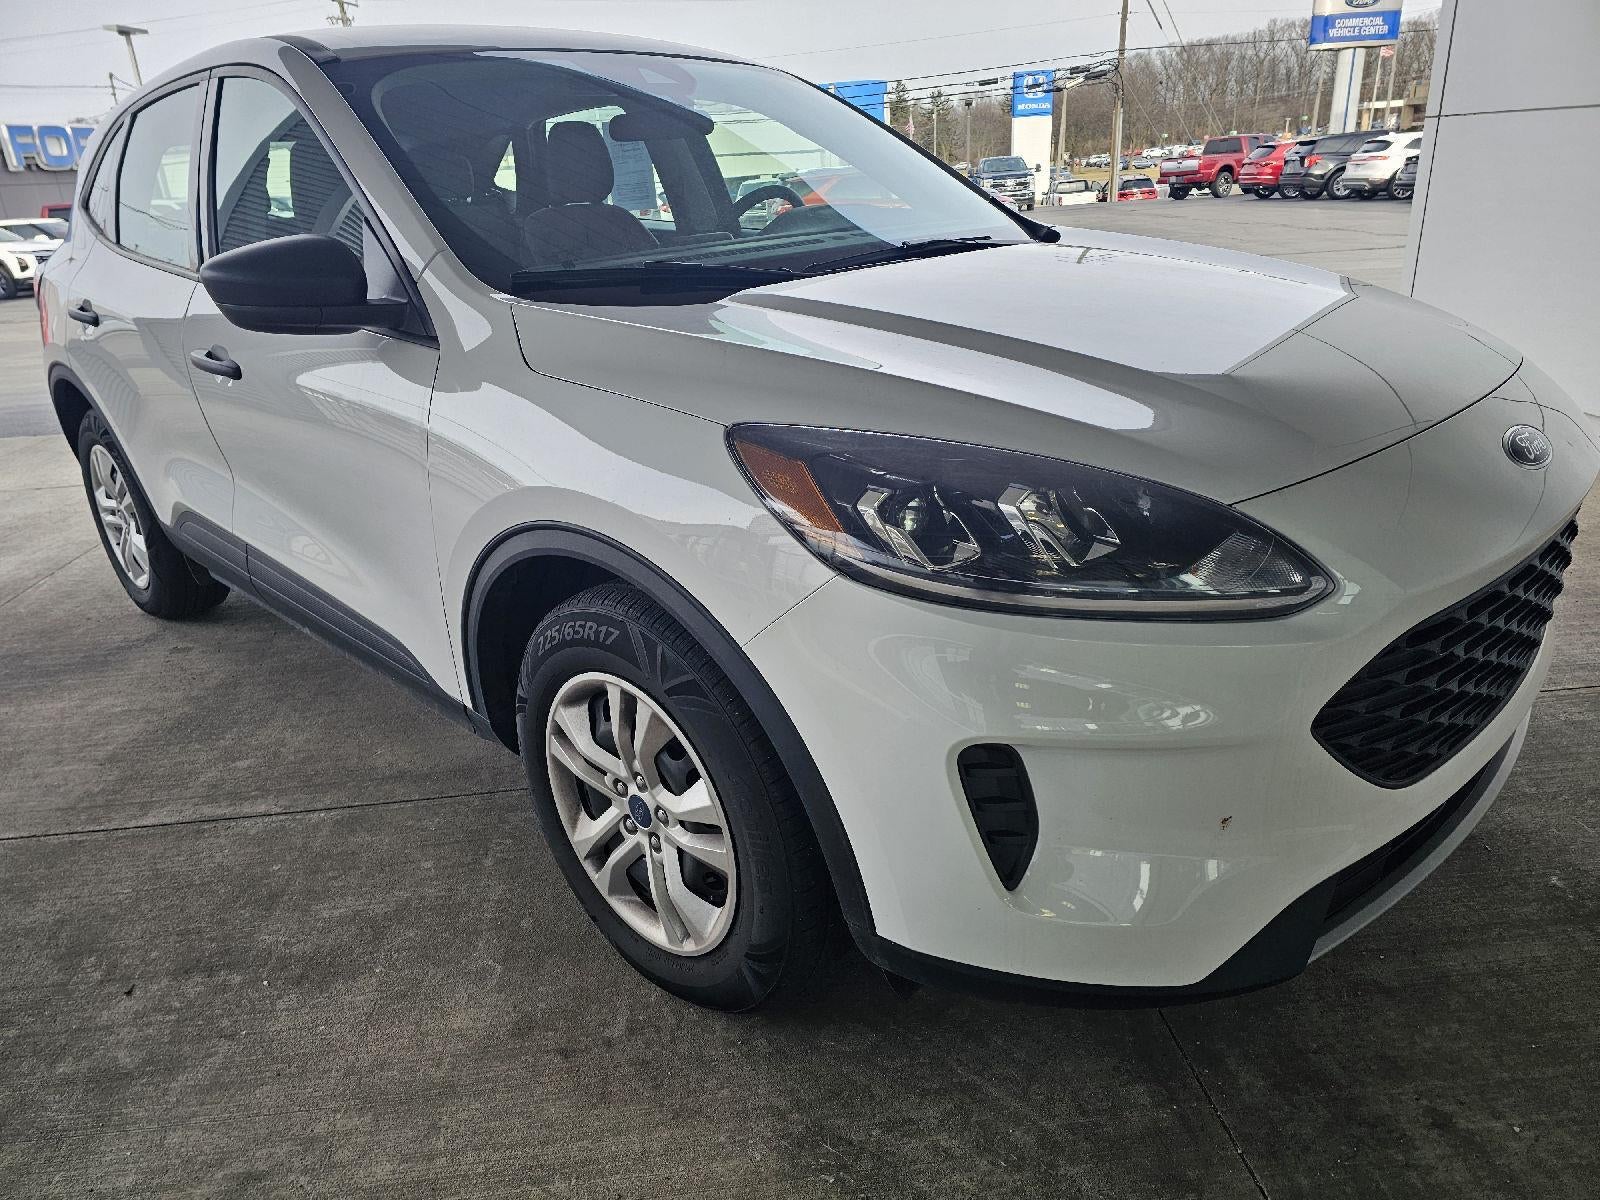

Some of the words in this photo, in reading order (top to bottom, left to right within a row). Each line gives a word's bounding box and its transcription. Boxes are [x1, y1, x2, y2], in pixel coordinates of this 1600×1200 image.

[1335, 16, 1384, 28] COMMERCIAL
[1329, 26, 1360, 37] VEHICLE
[1360, 25, 1389, 35] CENTER
[537, 620, 620, 656] 225/65R17
